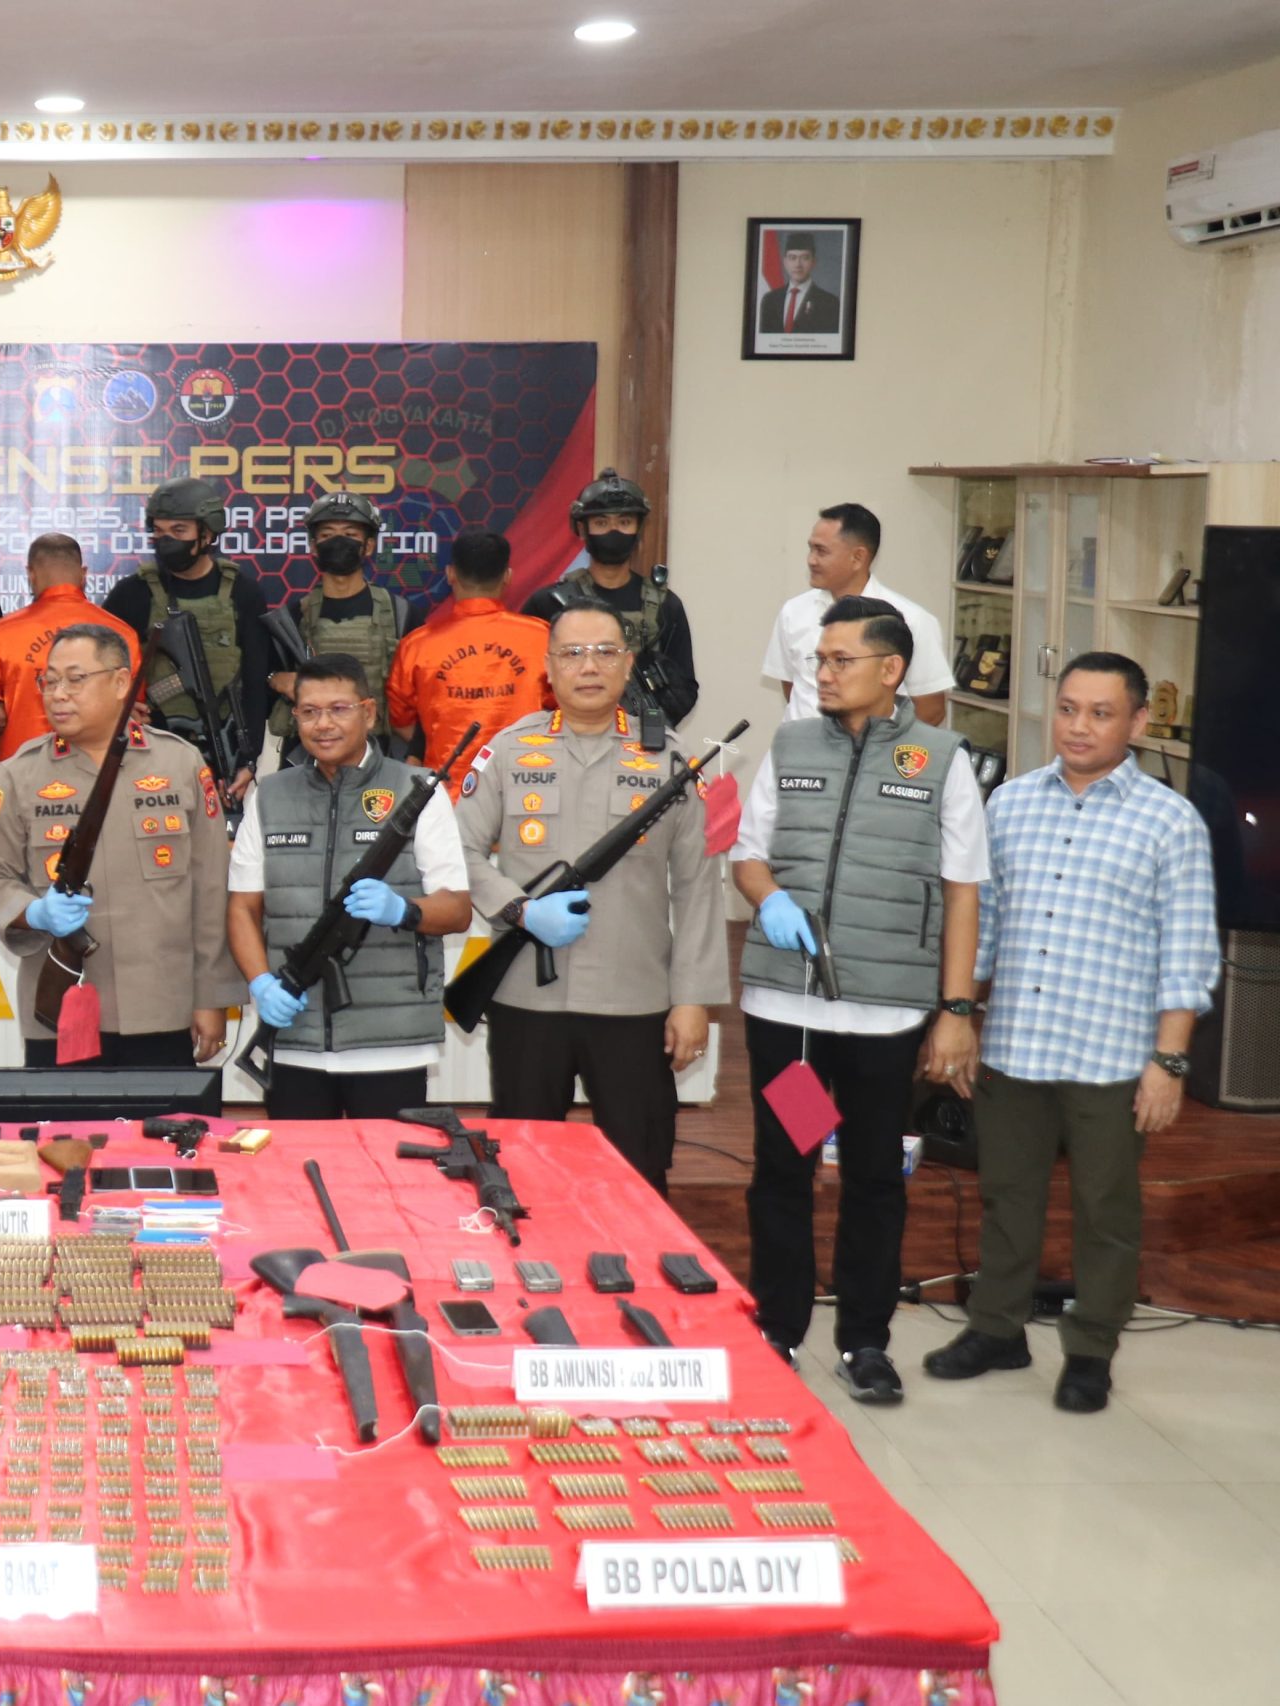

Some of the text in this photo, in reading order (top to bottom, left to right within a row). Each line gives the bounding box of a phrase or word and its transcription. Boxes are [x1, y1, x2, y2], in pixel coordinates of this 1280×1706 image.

[190, 445, 397, 494] PERS
[212, 531, 311, 554] OLDA
[24, 627, 63, 664] POLD
[436, 642, 527, 682] POLDA PAPUA
[446, 682, 516, 700] TAHANAN
[512, 772, 558, 785] YUSUF
[617, 774, 663, 790] POLRI
[780, 778, 822, 789] SATRIA
[881, 784, 931, 800] KASUBDIT
[134, 794, 180, 809] POLRI
[35, 804, 82, 817] FAIZAL
[287, 834, 307, 844] JAYA
[529, 1359, 549, 1388] BB
[554, 1359, 615, 1388] AMUNISI
[659, 1359, 704, 1388] BUTIR
[603, 1556, 802, 1594] BB POLDA DIY
